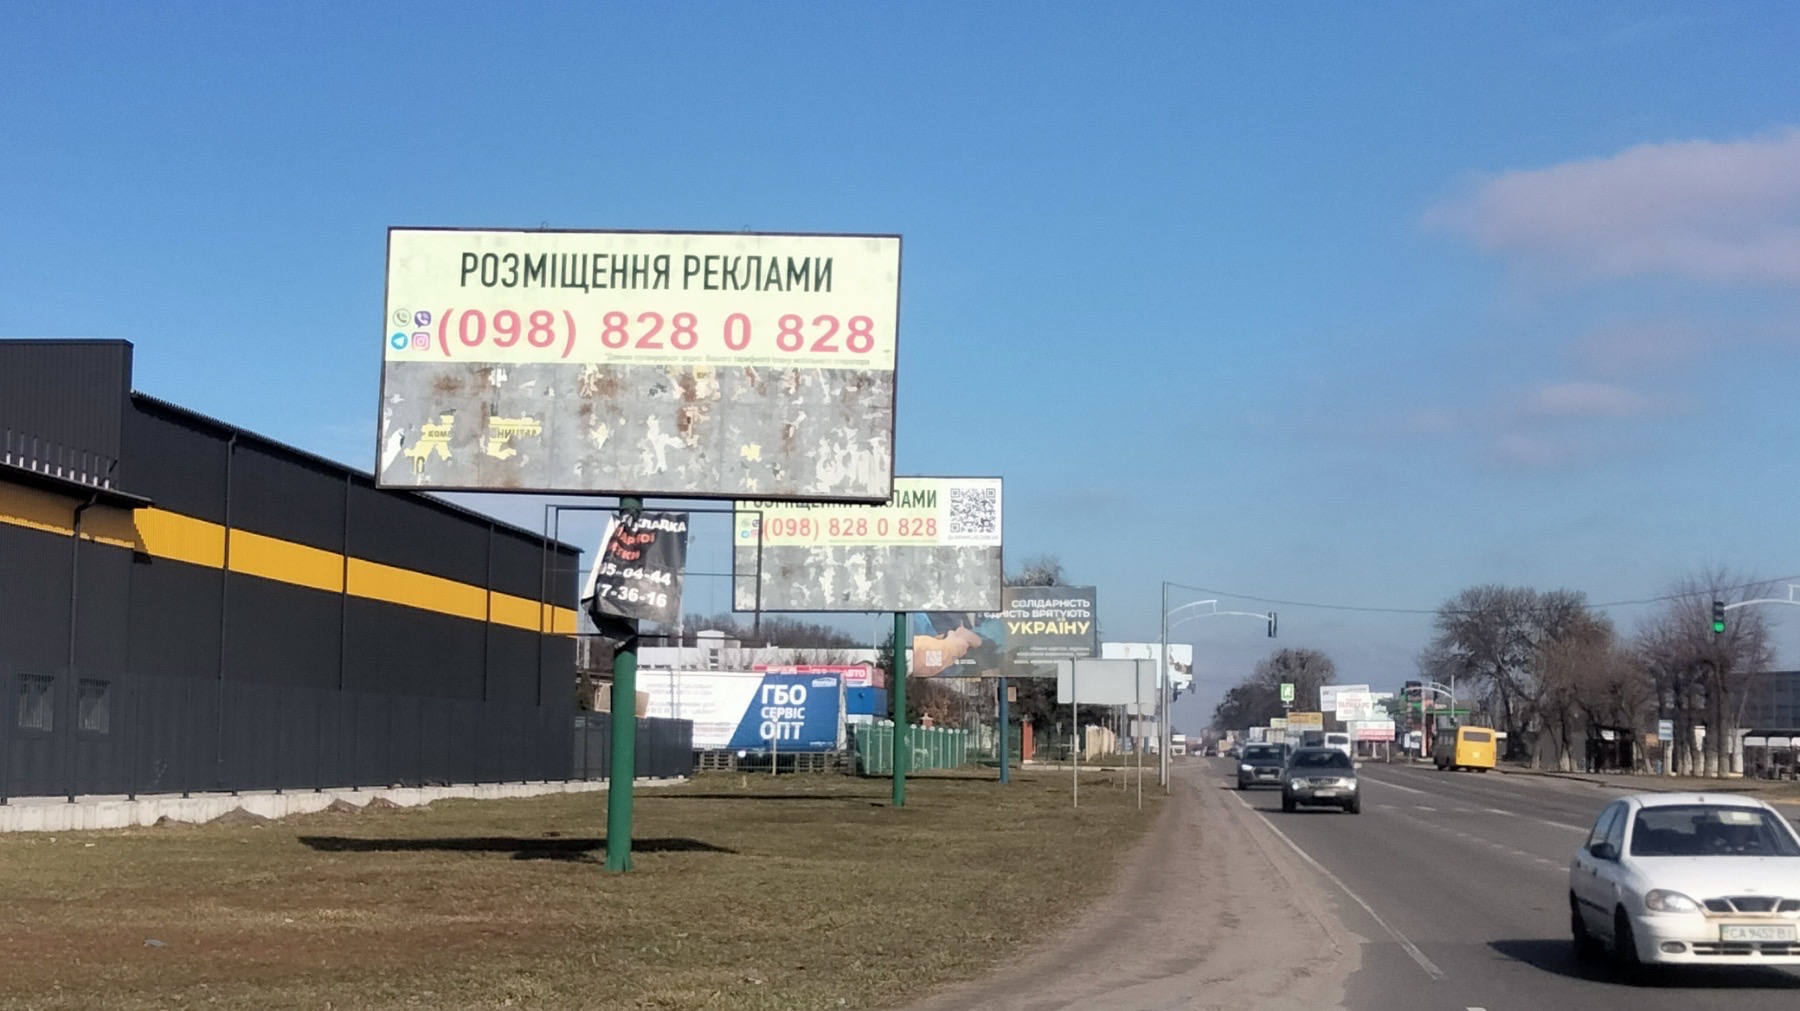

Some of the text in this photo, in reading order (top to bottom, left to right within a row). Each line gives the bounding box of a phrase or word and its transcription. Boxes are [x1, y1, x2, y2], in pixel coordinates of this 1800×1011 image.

[460, 251, 833, 294] РОЗМІЩЕННЯ РЕКЛАМИ
[437, 307, 876, 358] (098) 828 0 828
[763, 517, 938, 541] (098) 828 0 828
[1011, 598, 1091, 609] СОЛІДАРНІСТЬ
[1031, 609, 1091, 618] ВРЯТУЮТЬ
[1007, 617, 1091, 635] УКРАЇНУ
[761, 683, 807, 705] ГБО
[760, 706, 806, 719] СЕРВІС
[759, 721, 805, 740] ОПТ
